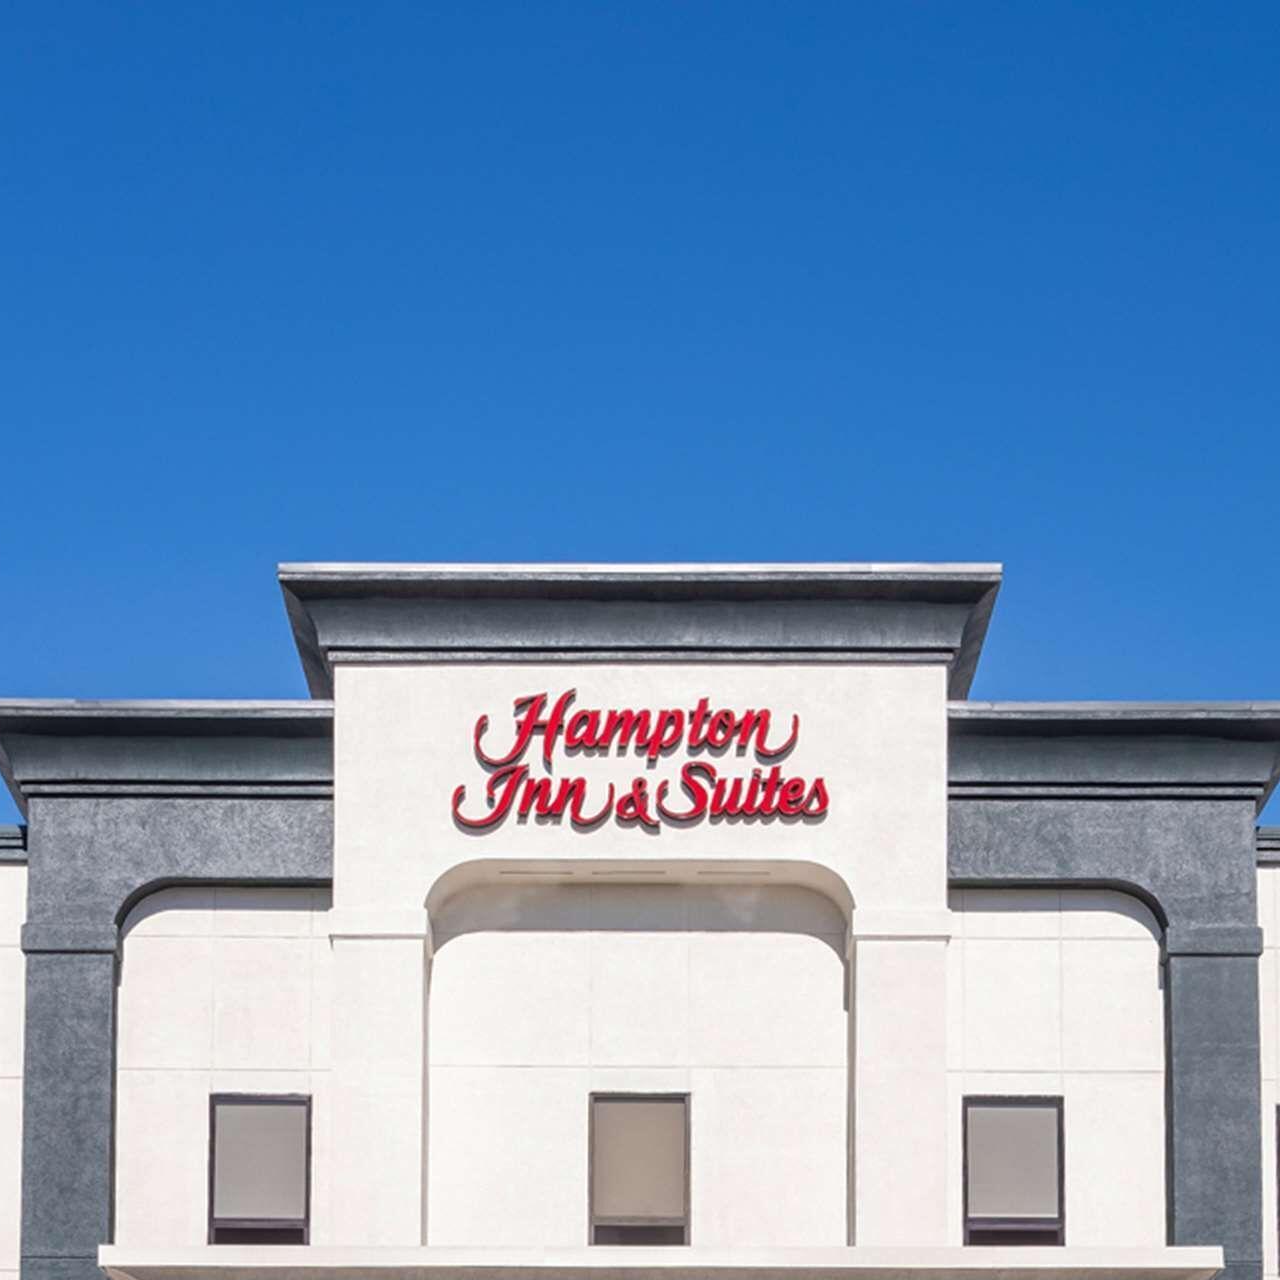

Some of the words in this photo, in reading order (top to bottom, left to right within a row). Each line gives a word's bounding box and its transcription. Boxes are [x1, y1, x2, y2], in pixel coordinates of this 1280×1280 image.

[474, 688, 800, 766] Hampton
[452, 764, 615, 827] Inn
[616, 777, 660, 826] &
[657, 761, 830, 820] Suites
